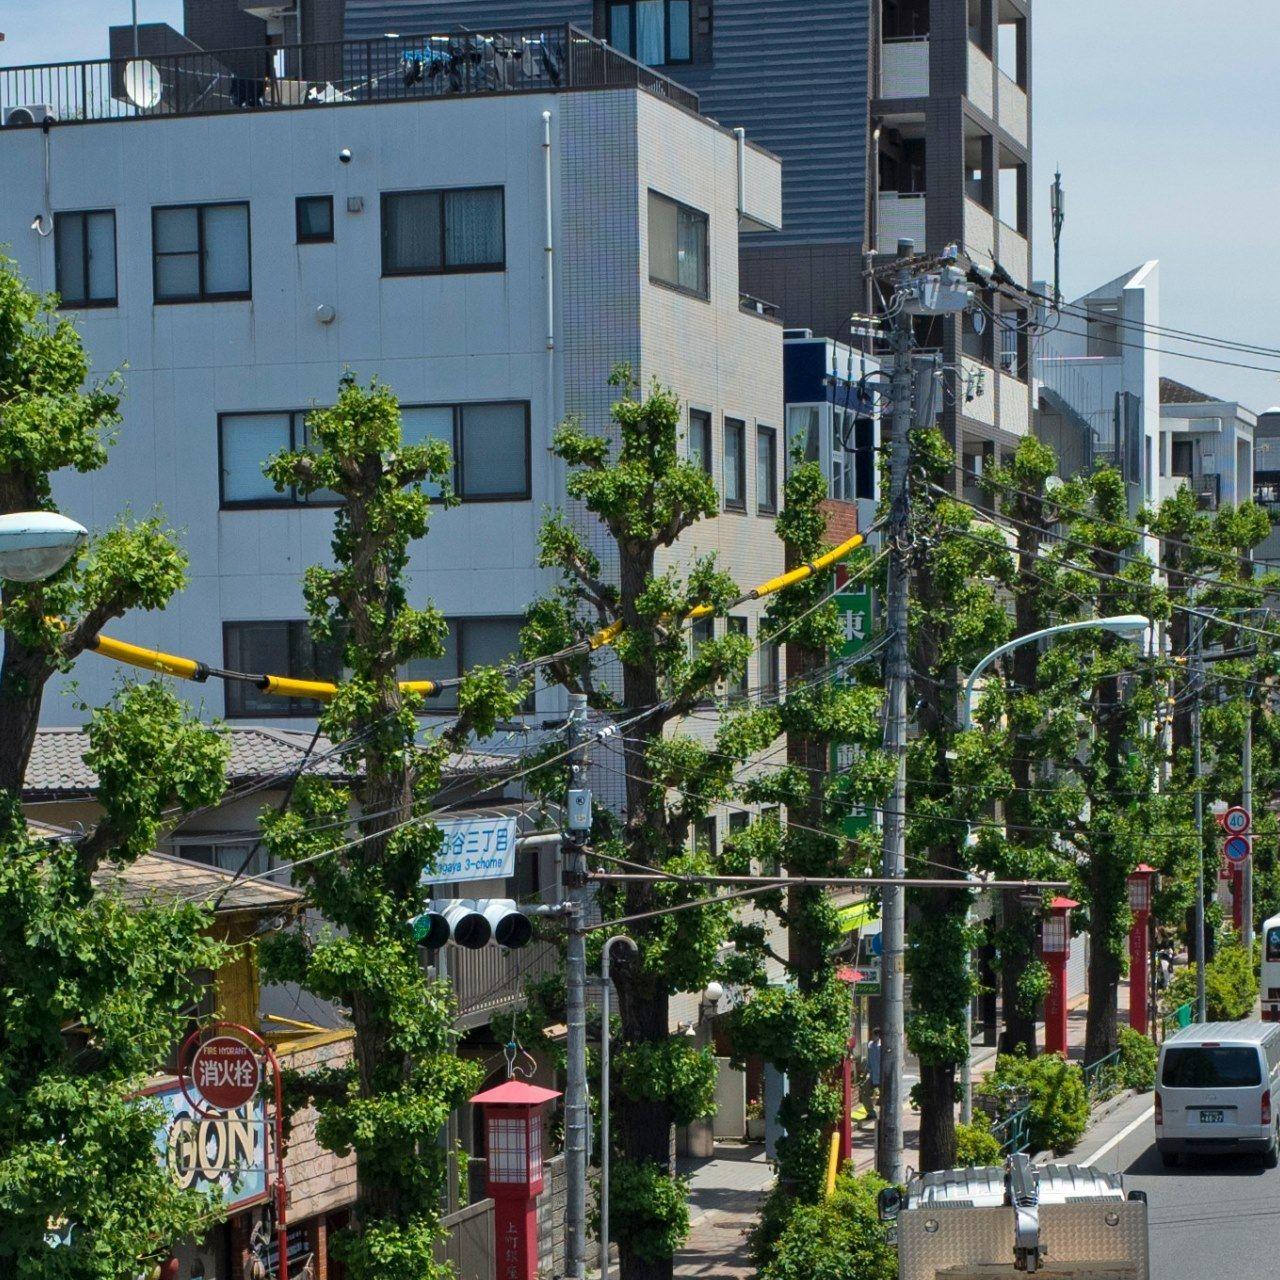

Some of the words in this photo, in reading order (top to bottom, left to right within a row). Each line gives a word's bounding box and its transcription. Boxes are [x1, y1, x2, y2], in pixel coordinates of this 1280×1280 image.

[1230, 815, 1244, 827] 40
[465, 856, 503, 870] 3-chome
[203, 1047, 218, 1055] FIRE
[219, 1046, 248, 1055] HYDRANT
[199, 1059, 253, 1087] 消火栓
